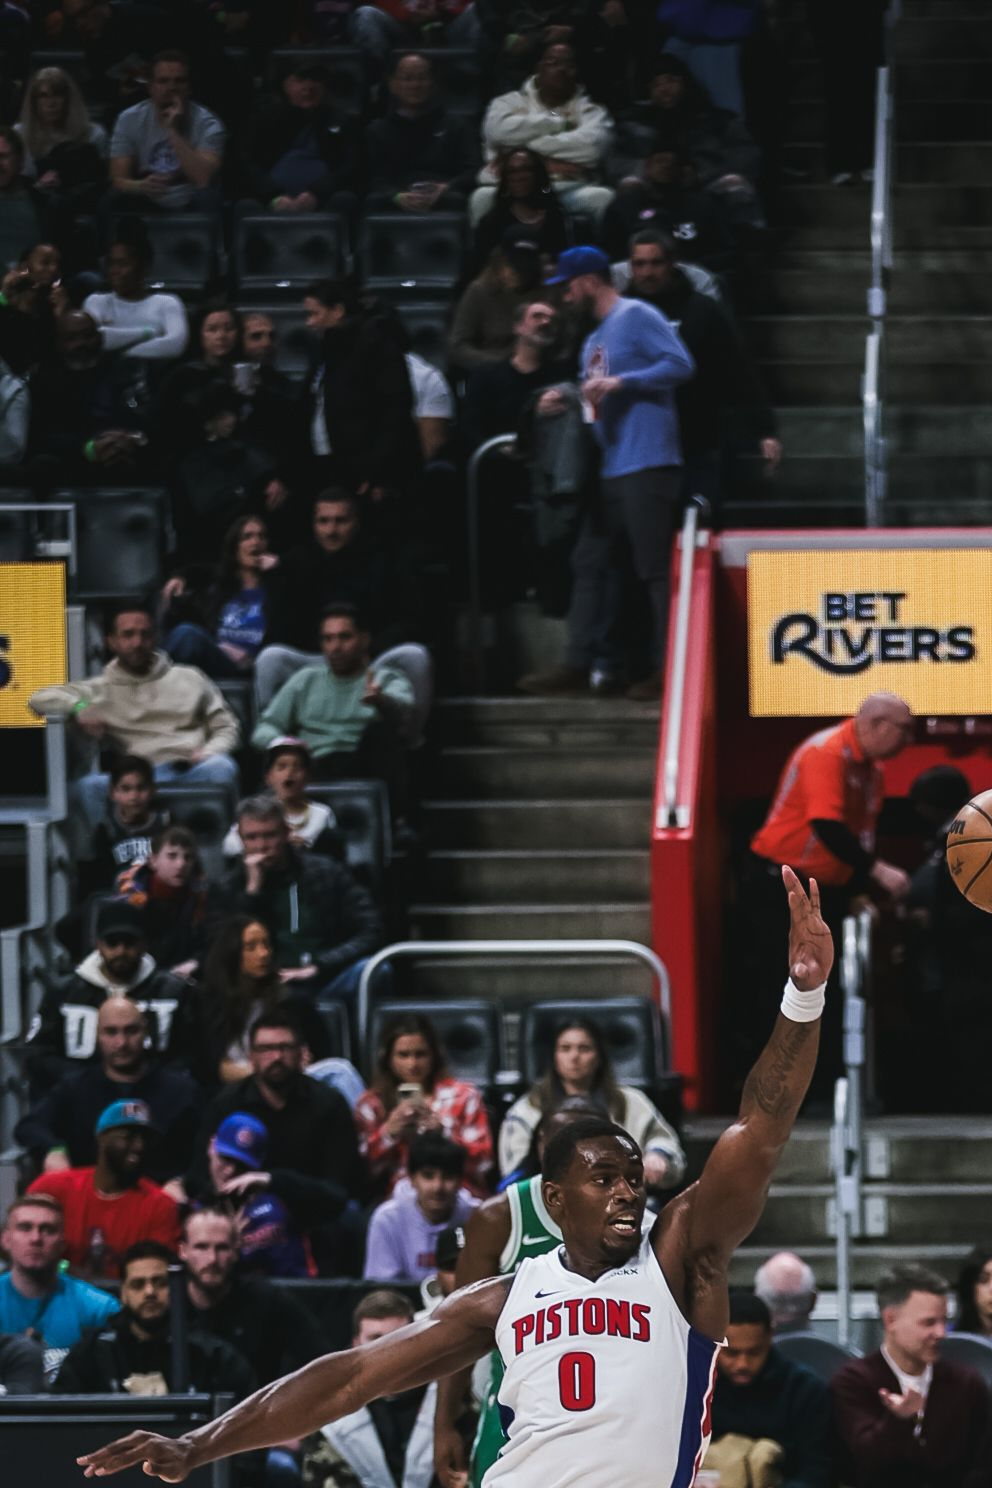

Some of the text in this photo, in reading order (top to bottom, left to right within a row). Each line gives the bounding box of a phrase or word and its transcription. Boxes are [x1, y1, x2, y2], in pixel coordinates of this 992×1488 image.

[824, 592, 907, 621] BET
[772, 613, 977, 676] RIVERS
[59, 999, 179, 1059] DT
[512, 1297, 652, 1357] PISTONS
[558, 1351, 596, 1412] 0
